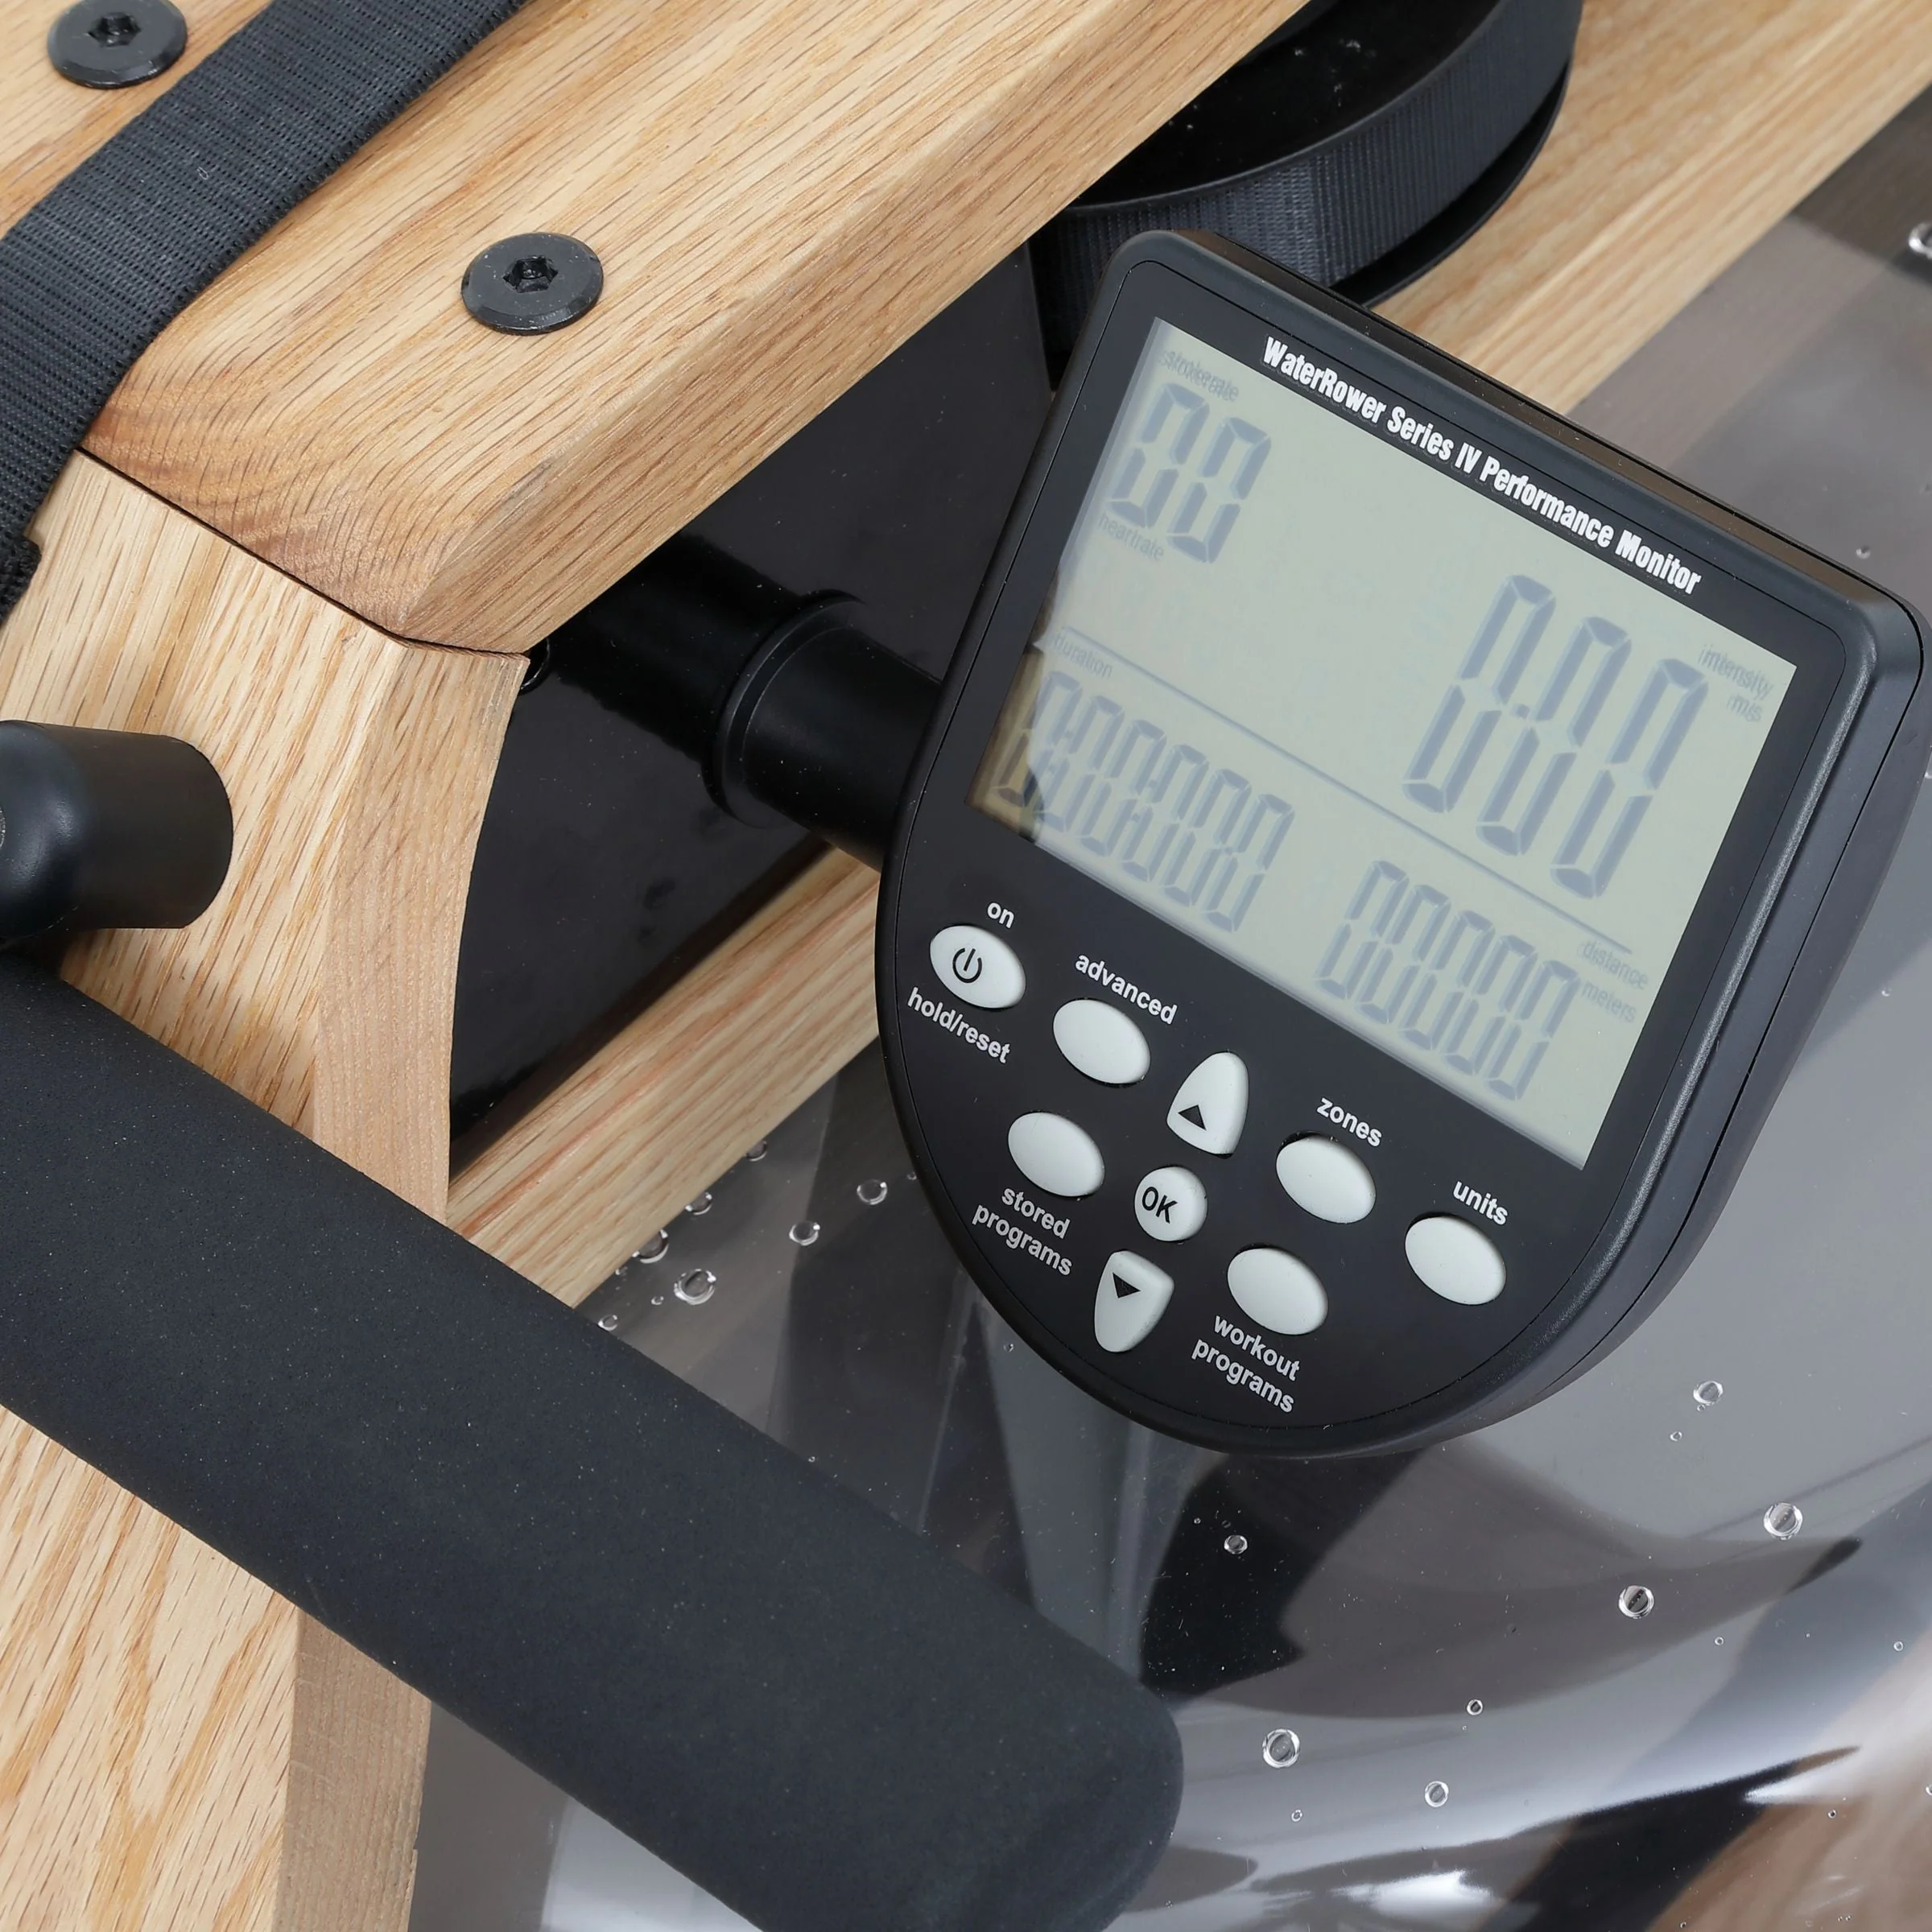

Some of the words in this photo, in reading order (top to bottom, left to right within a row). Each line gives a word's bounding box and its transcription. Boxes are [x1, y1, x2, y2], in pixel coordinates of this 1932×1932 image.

[1263, 336, 1386, 424] WaterRower
[1386, 407, 1455, 460] Series
[1455, 442, 1482, 474] IV
[1480, 456, 1613, 548] Performance
[1614, 530, 1702, 595] Monitor
[1097, 514, 1165, 562] heartrate
[1054, 634, 1113, 679] duration
[1699, 644, 1773, 701] intensity
[987, 902, 1015, 928] on
[1075, 954, 1178, 1025] advanced
[1578, 939, 1649, 990] distance
[906, 986, 1010, 1063] hold/reset
[1581, 979, 1637, 1023] meters
[1316, 1096, 1383, 1147] zones
[1001, 1187, 1071, 1239] stored
[1141, 1187, 1178, 1224] OK
[1452, 1181, 1509, 1226] units
[972, 1204, 1073, 1276] programs
[1213, 1315, 1301, 1381] workout
[1191, 1338, 1294, 1414] programs
